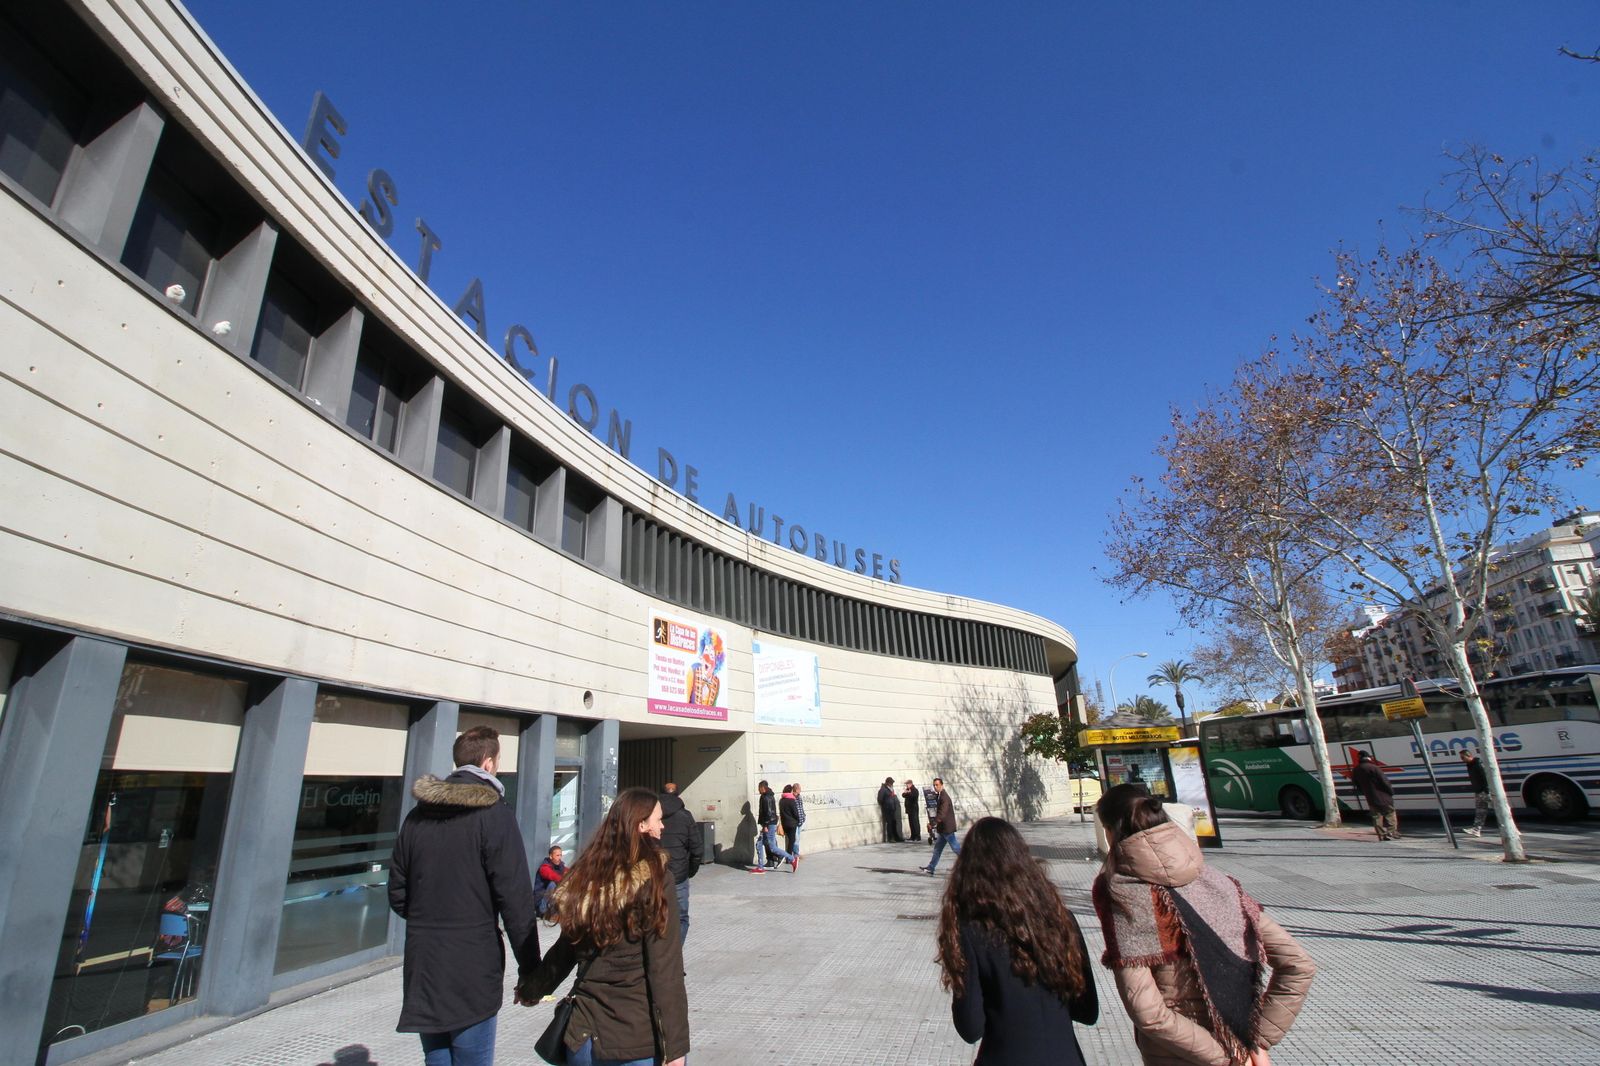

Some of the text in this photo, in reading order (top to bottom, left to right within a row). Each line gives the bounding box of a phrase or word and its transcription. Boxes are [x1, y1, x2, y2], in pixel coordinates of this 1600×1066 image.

[302, 91, 902, 584] ESTACION DE AUTOBUSES
[654, 704, 723, 717] www.lacasadelosdisfraces.es
